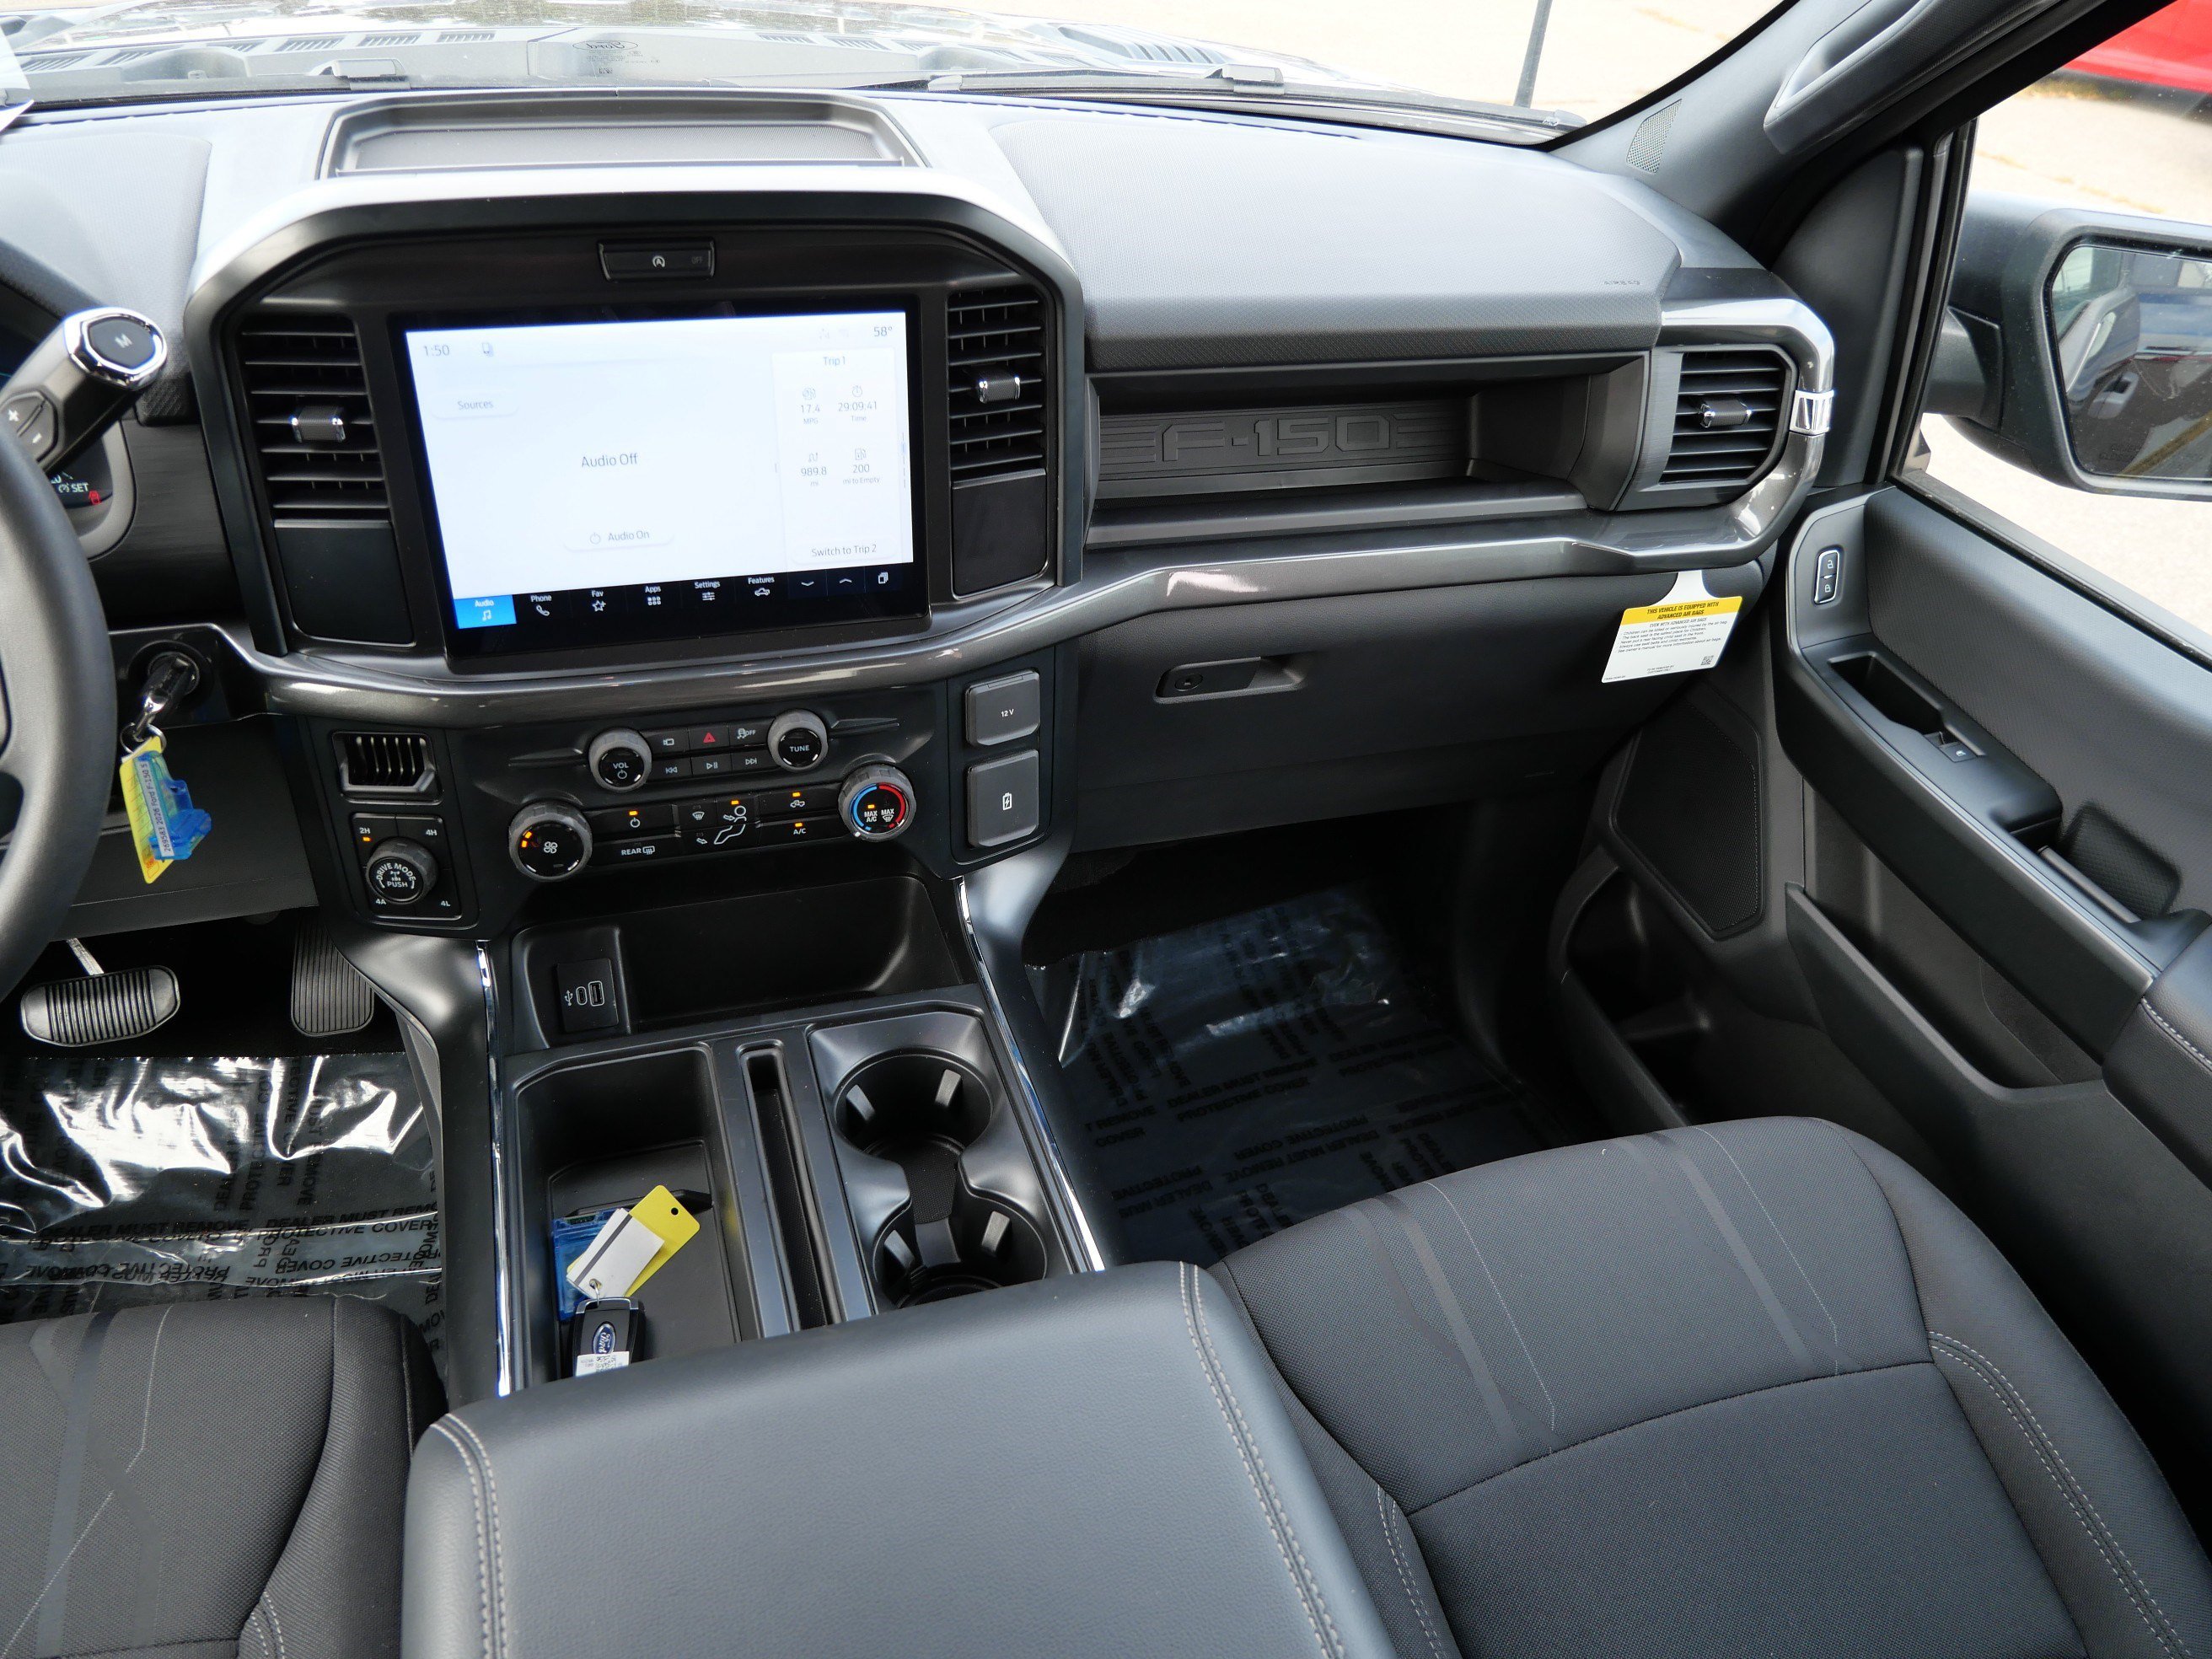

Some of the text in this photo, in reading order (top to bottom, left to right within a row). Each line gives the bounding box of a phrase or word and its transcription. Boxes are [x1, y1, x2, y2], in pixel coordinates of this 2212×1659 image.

[423, 344, 450, 357] 1:50
[823, 356, 840, 366] Trip
[457, 399, 494, 411] Sources
[801, 404, 820, 414] 17.4
[1162, 415, 1391, 462] F-150
[581, 453, 639, 469] Audio Off
[801, 466, 827, 477] 989.8
[852, 464, 870, 474] 200
[860, 476, 880, 486] Empty
[71, 481, 89, 492] SET
[607, 529, 650, 542] Audio On
[811, 544, 877, 557] Switch to Trip 2
[694, 580, 721, 589] Settings
[748, 576, 775, 585] Features
[645, 585, 662, 593] Apps
[530, 593, 552, 603] Phone
[475, 599, 495, 608] Audio
[1001, 709, 1009, 717] 12
[789, 744, 810, 753] TUNE
[149, 791, 158, 807] Ford
[621, 847, 642, 856] REAR
[376, 862, 416, 882] DRIVE MODE
[598, 1330, 611, 1353] Ford
